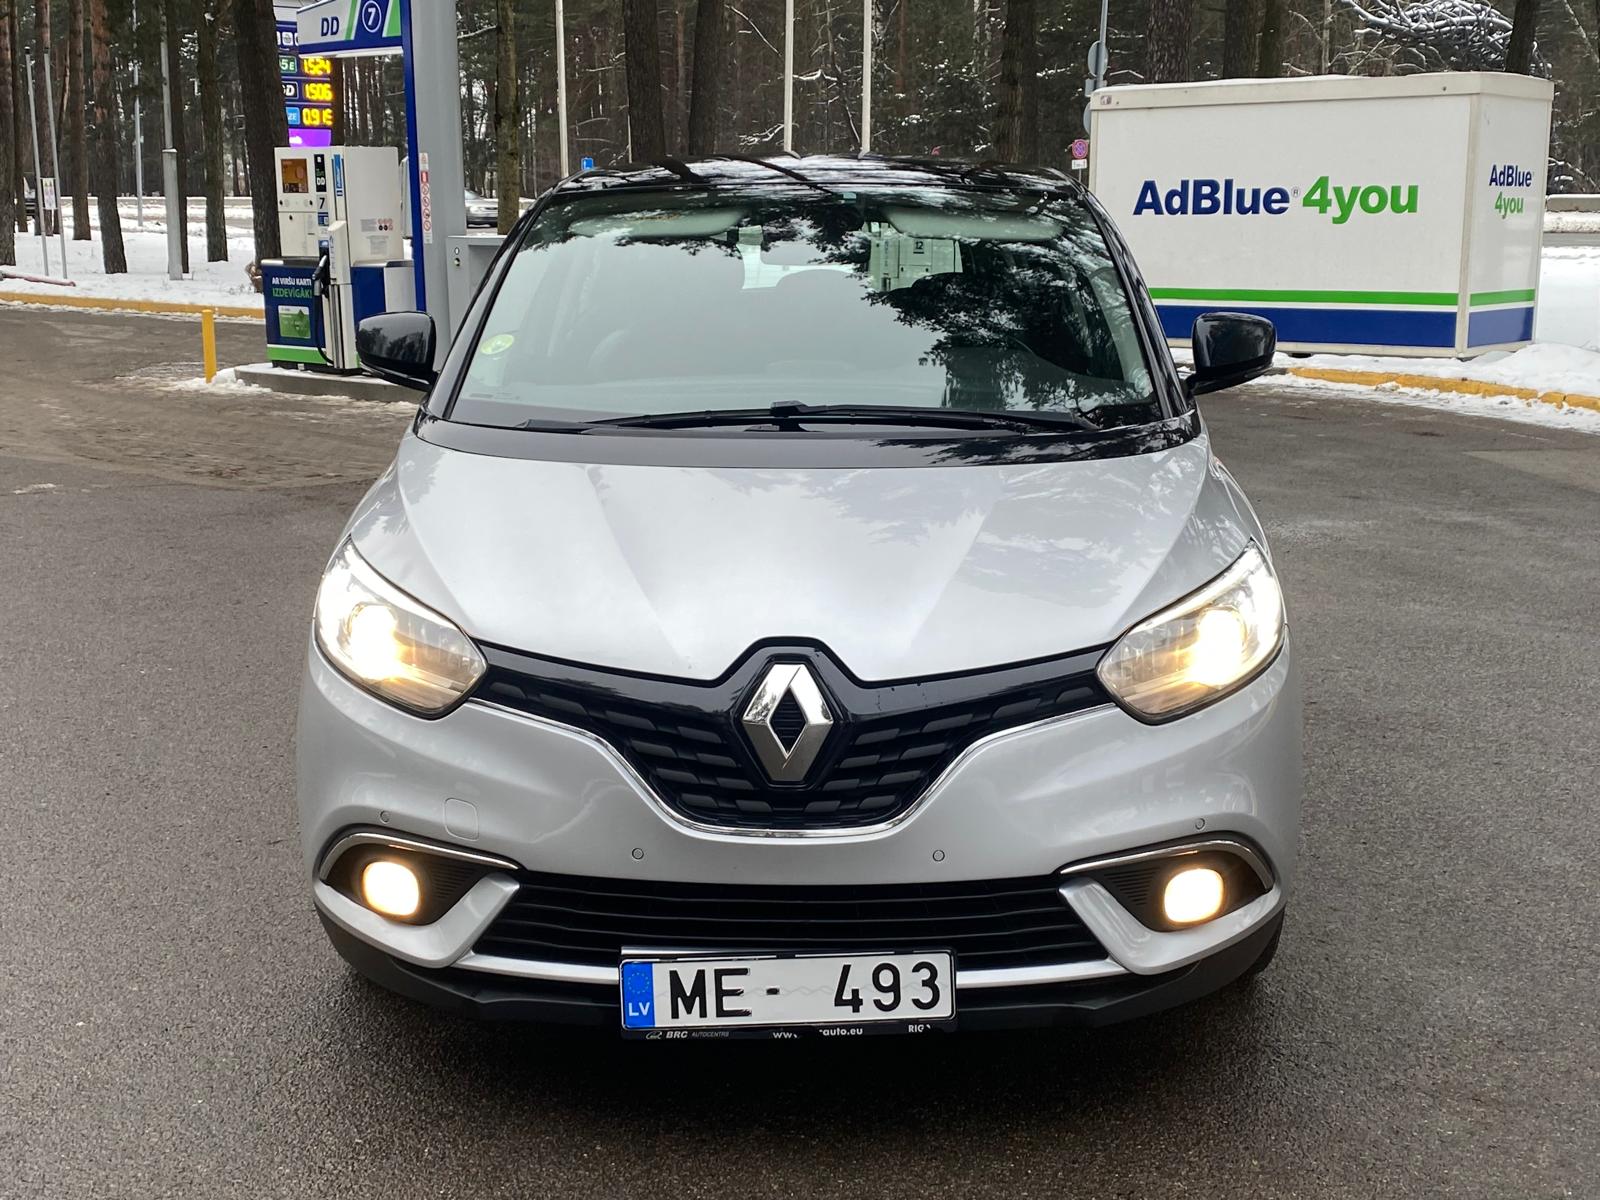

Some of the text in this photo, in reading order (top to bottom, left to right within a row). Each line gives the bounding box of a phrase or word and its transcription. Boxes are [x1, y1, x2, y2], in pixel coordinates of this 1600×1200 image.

[367, 7, 376, 26] 7
[321, 17, 340, 37] DD
[316, 177, 325, 185] DD
[319, 197, 326, 210] 7
[1302, 175, 1419, 225] 4you
[1494, 191, 1524, 220] 4you
[915, 241, 924, 250] 12
[272, 277, 280, 285] AR
[834, 961, 941, 1013] 493
[628, 1001, 650, 1017] LV
[665, 1030, 688, 1039] BRC
[819, 1026, 863, 1036] auto.eu
